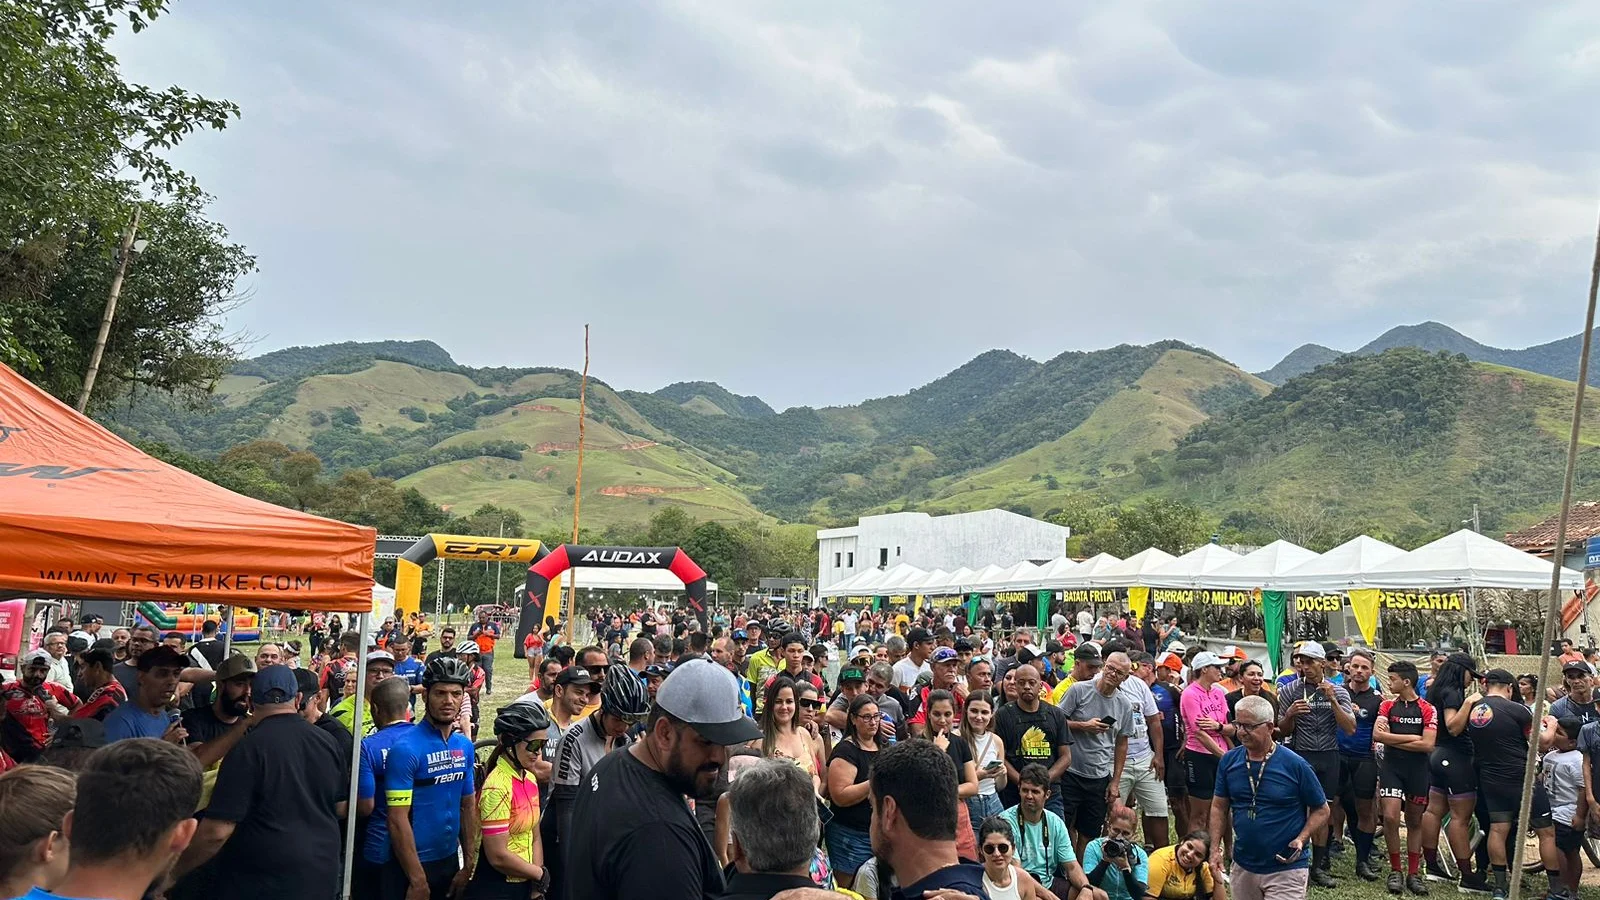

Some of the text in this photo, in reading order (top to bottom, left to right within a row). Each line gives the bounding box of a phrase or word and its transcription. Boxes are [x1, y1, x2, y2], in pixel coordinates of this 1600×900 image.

[581, 549, 662, 565] AUDAX
[39, 570, 313, 591] WWWTSWBIKE.COM
[995, 592, 1026, 602] SALGADOS
[1063, 590, 1113, 602] BATATA FRITA
[1153, 589, 1193, 603] BARRACA
[1211, 591, 1245, 606] MILHO
[1296, 595, 1340, 611] DOCES
[1379, 592, 1461, 610] PESCARIA
[427, 750, 451, 764] RAFAEL
[558, 724, 584, 780] BOTAFOGO
